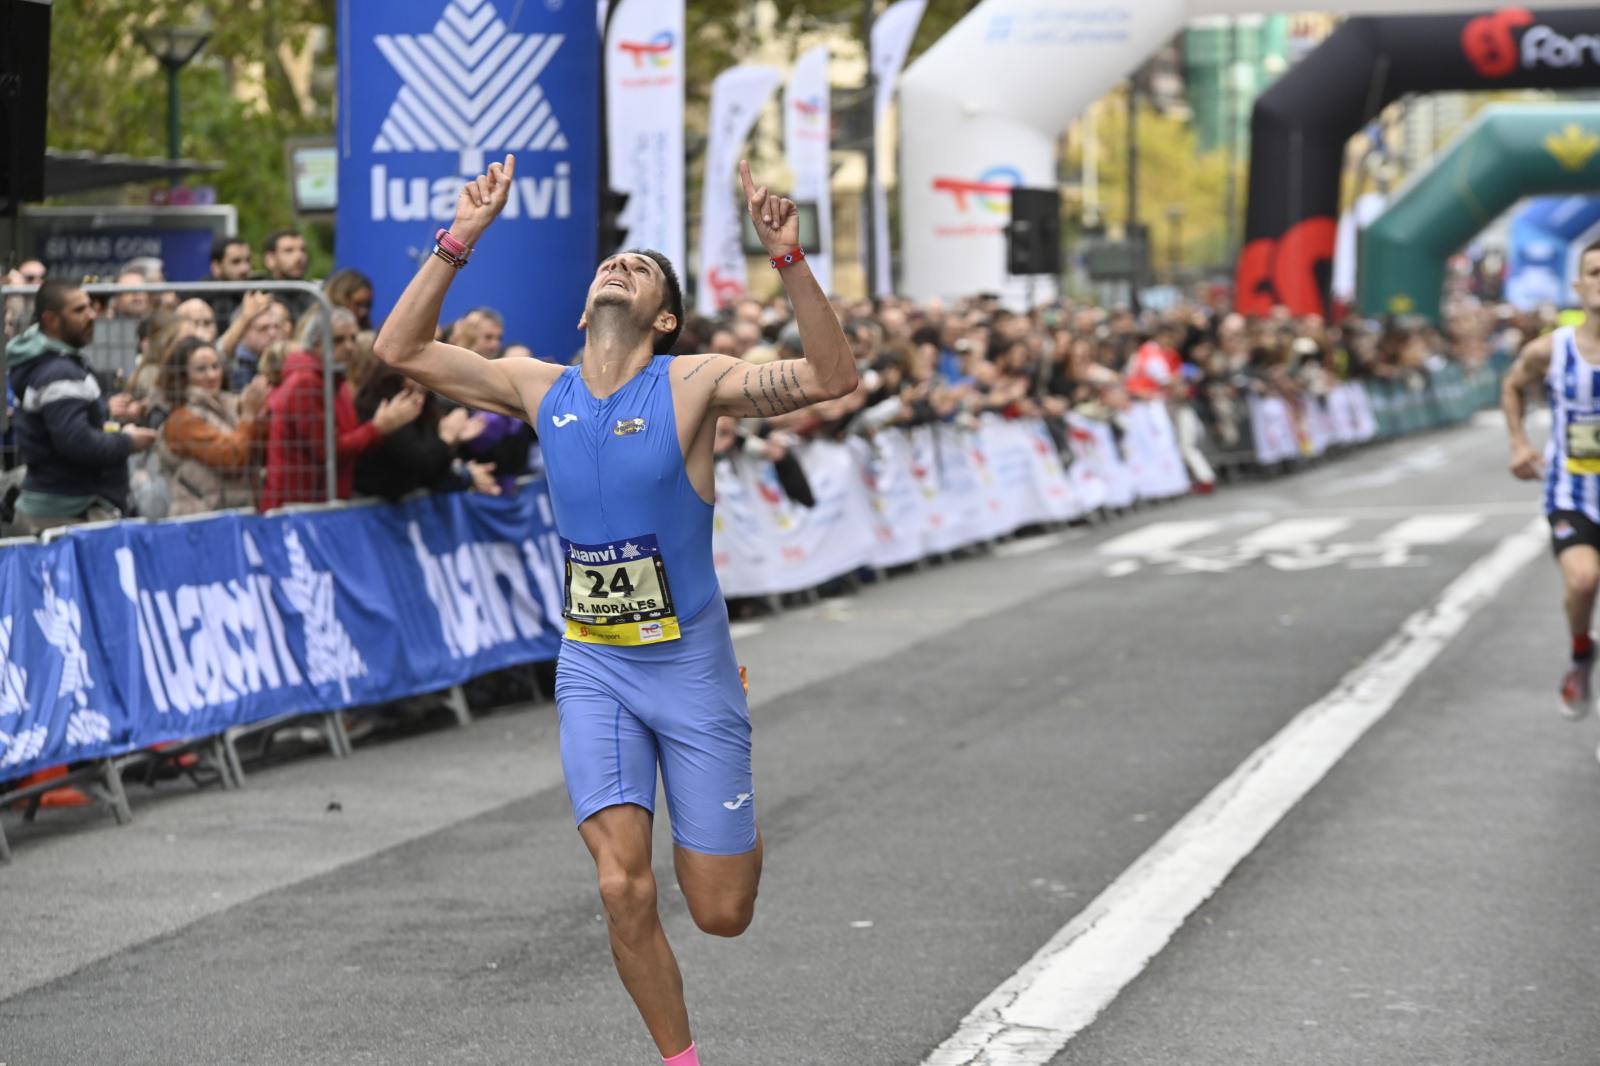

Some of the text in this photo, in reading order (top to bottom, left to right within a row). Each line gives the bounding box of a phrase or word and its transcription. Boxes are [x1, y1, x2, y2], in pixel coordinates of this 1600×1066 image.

[585, 567, 634, 598] 24
[578, 599, 656, 614] R. MORALES
[115, 530, 302, 715] luanvi
